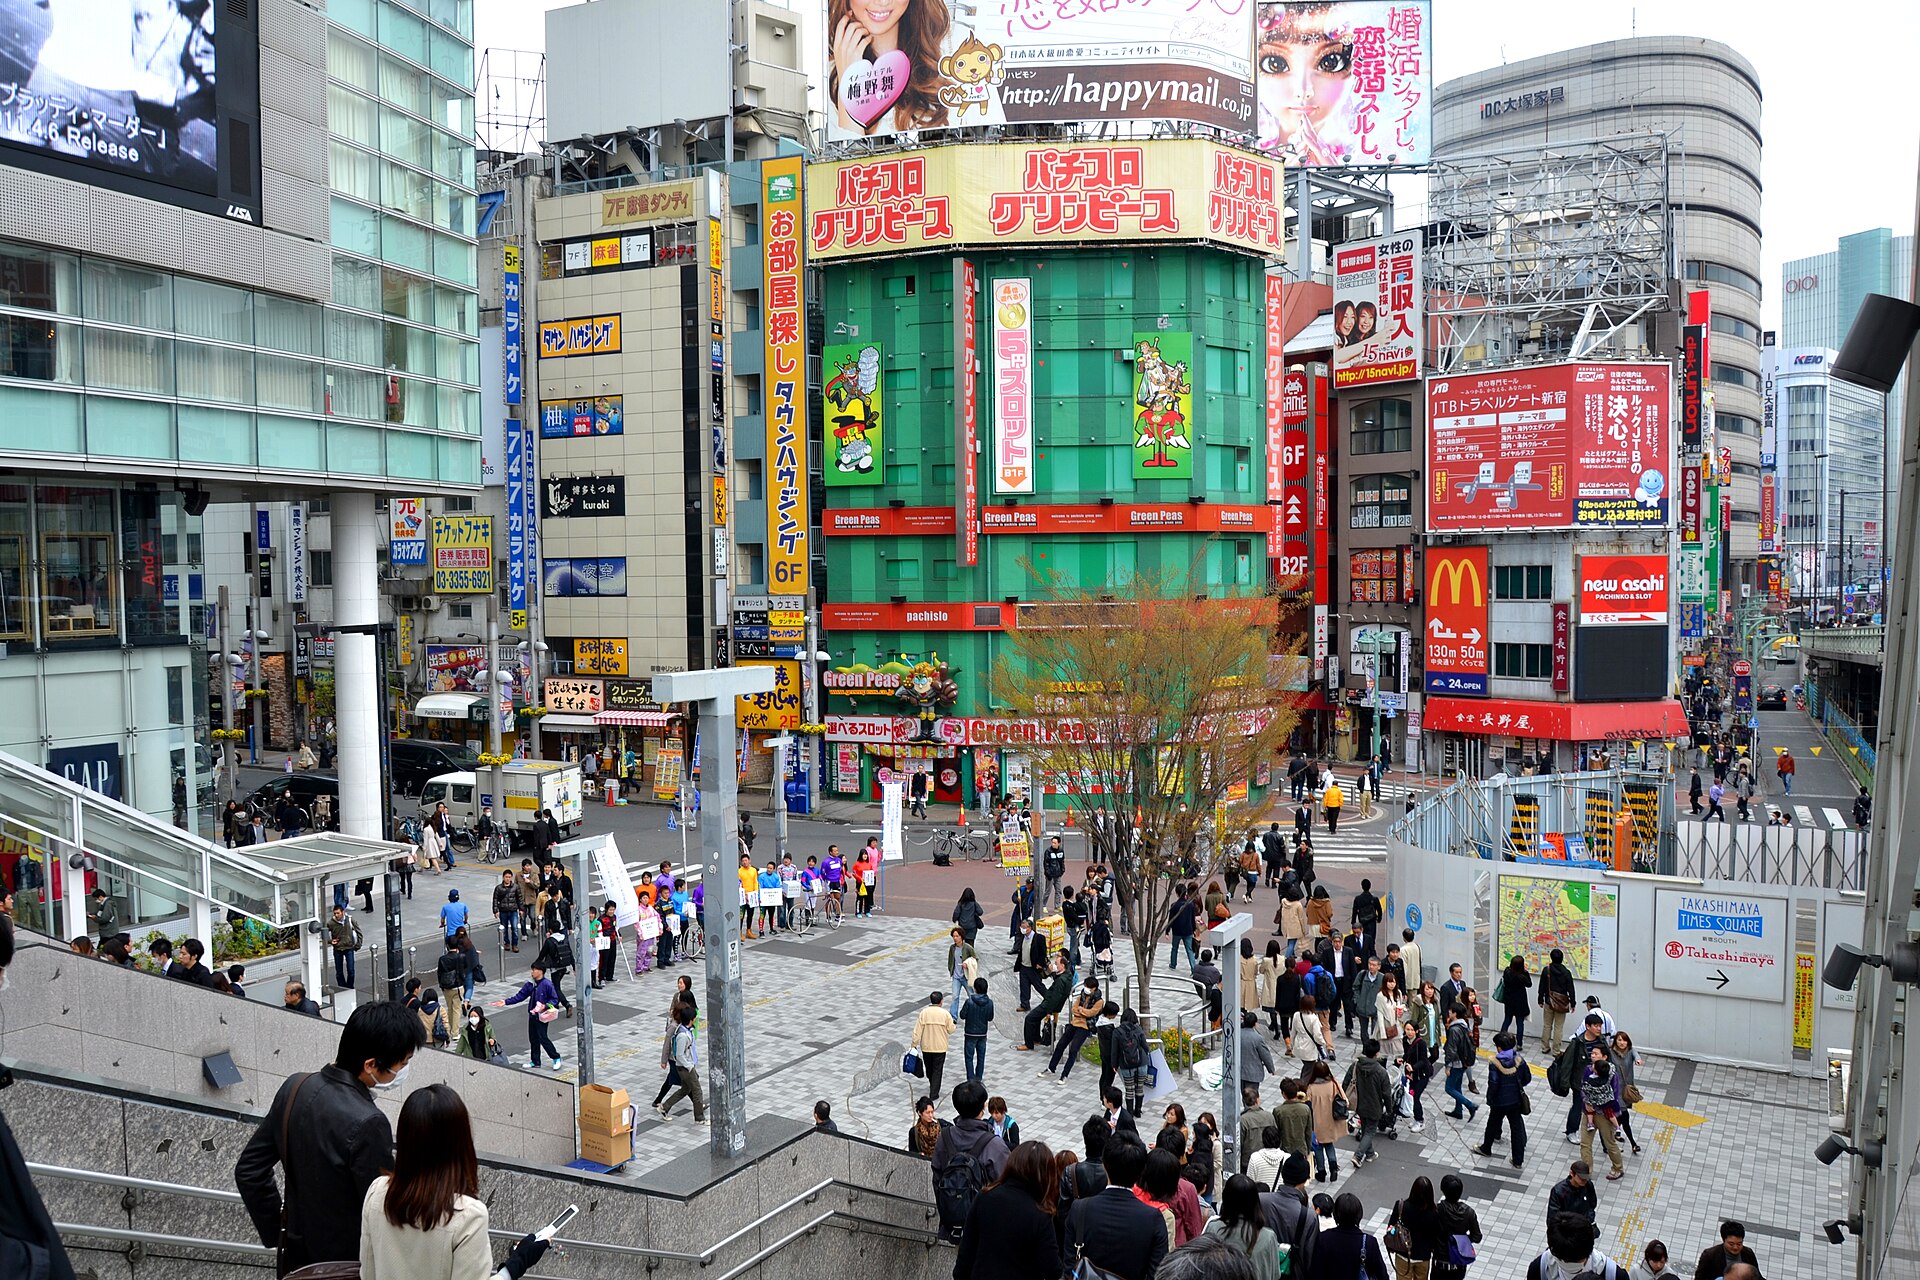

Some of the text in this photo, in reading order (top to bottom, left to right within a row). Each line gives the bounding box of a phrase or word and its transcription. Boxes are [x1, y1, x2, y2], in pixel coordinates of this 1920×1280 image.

[1010, 46, 1161, 59] 日本最大級の恋愛コミュニティサイト
[849, 67, 893, 81] イメージモデル
[1007, 70, 1037, 79] ハピモン
[1387, 6, 1422, 152] 婚活シタイし。
[847, 76, 894, 100] 梅野舞
[1003, 73, 1252, 120] http://happymail.co.jp
[1353, 26, 1386, 160] 恋活スルし。
[67, 126, 139, 162] Release
[1025, 148, 1143, 192] パチスロ
[1214, 150, 1275, 206] パチスロ
[836, 156, 926, 207] パチスロ
[226, 205, 253, 222] LISA
[606, 192, 688, 217] 7F 麻雀ダンディ
[989, 189, 1179, 235] グリンピース
[813, 196, 953, 252] グリンピース
[1209, 193, 1281, 249] グリンピース
[568, 252, 579, 260] 7F
[594, 244, 619, 261] 麻雀
[636, 244, 648, 252] 7F
[658, 245, 694, 260] ダンディ
[1378, 239, 1413, 257] 女性の
[505, 251, 518, 267] 5F
[768, 211, 798, 374] お部屋探し
[1378, 259, 1388, 317] お仕事探し
[964, 266, 973, 340] パチスロ
[1390, 255, 1413, 341] 高収入
[1268, 280, 1280, 348] パチスロ
[506, 281, 520, 394] カラオケ
[543, 321, 613, 352] タウンハウジング
[1794, 355, 1823, 365] KEIO
[1336, 362, 1414, 382] http://15navi.jp/
[1432, 383, 1449, 395] JTB
[1685, 336, 1700, 434] disk union
[576, 401, 588, 415] 5F
[1433, 391, 1567, 416] JTBトラベルゲート新宿
[965, 349, 974, 494] グリンピース
[1268, 355, 1281, 491] グリンピース
[1518, 412, 1546, 421] テーマ館
[1607, 394, 1628, 448] 決心。
[1501, 433, 1538, 441] 海外ハネムーン
[1631, 394, 1642, 474] ルックJTBの
[1283, 445, 1304, 465] 6F
[1501, 449, 1536, 457] ロイヤルデスク
[1765, 455, 1772, 463] P
[775, 381, 804, 555] タウンハウジング
[572, 484, 615, 495] 博多もつ鍋
[1685, 470, 1696, 507] GOLD
[583, 500, 609, 510] kuroki
[835, 514, 880, 524] Green Peas
[985, 512, 1036, 522] Green Peas
[1130, 511, 1183, 521] Green Peas
[1221, 511, 1253, 521] Green Peas
[1383, 515, 1411, 526] 0123
[1578, 509, 1661, 520] お申し込み受付中!!
[435, 520, 489, 543] チケットフナキ
[393, 541, 424, 560] カラオケ747
[1764, 541, 1771, 549] P
[582, 564, 614, 579] 夜空
[775, 561, 802, 583] 6F
[1280, 556, 1307, 576] B2F
[436, 570, 490, 589] 03-3355-6921
[1584, 574, 1664, 592] new asahi
[512, 612, 525, 627] 5F
[906, 610, 948, 622] pachislo
[1317, 616, 1325, 625] 6F
[1589, 614, 1616, 622] すぐそこ
[1429, 645, 1484, 658] 130m 50m
[548, 682, 601, 695] 讃岐うどん
[823, 671, 900, 688] Green Peas
[612, 685, 645, 696] クレープ
[553, 697, 585, 710] 生そば
[780, 715, 798, 728] 2F
[827, 722, 891, 736] 選べるスロット
[1455, 713, 1532, 730] 食堂 長野屋
[1681, 897, 1760, 916] TAKASHIMAYA
[1681, 913, 1760, 936] TIMES SQUARE
[1685, 946, 1775, 967] Takashimaya
